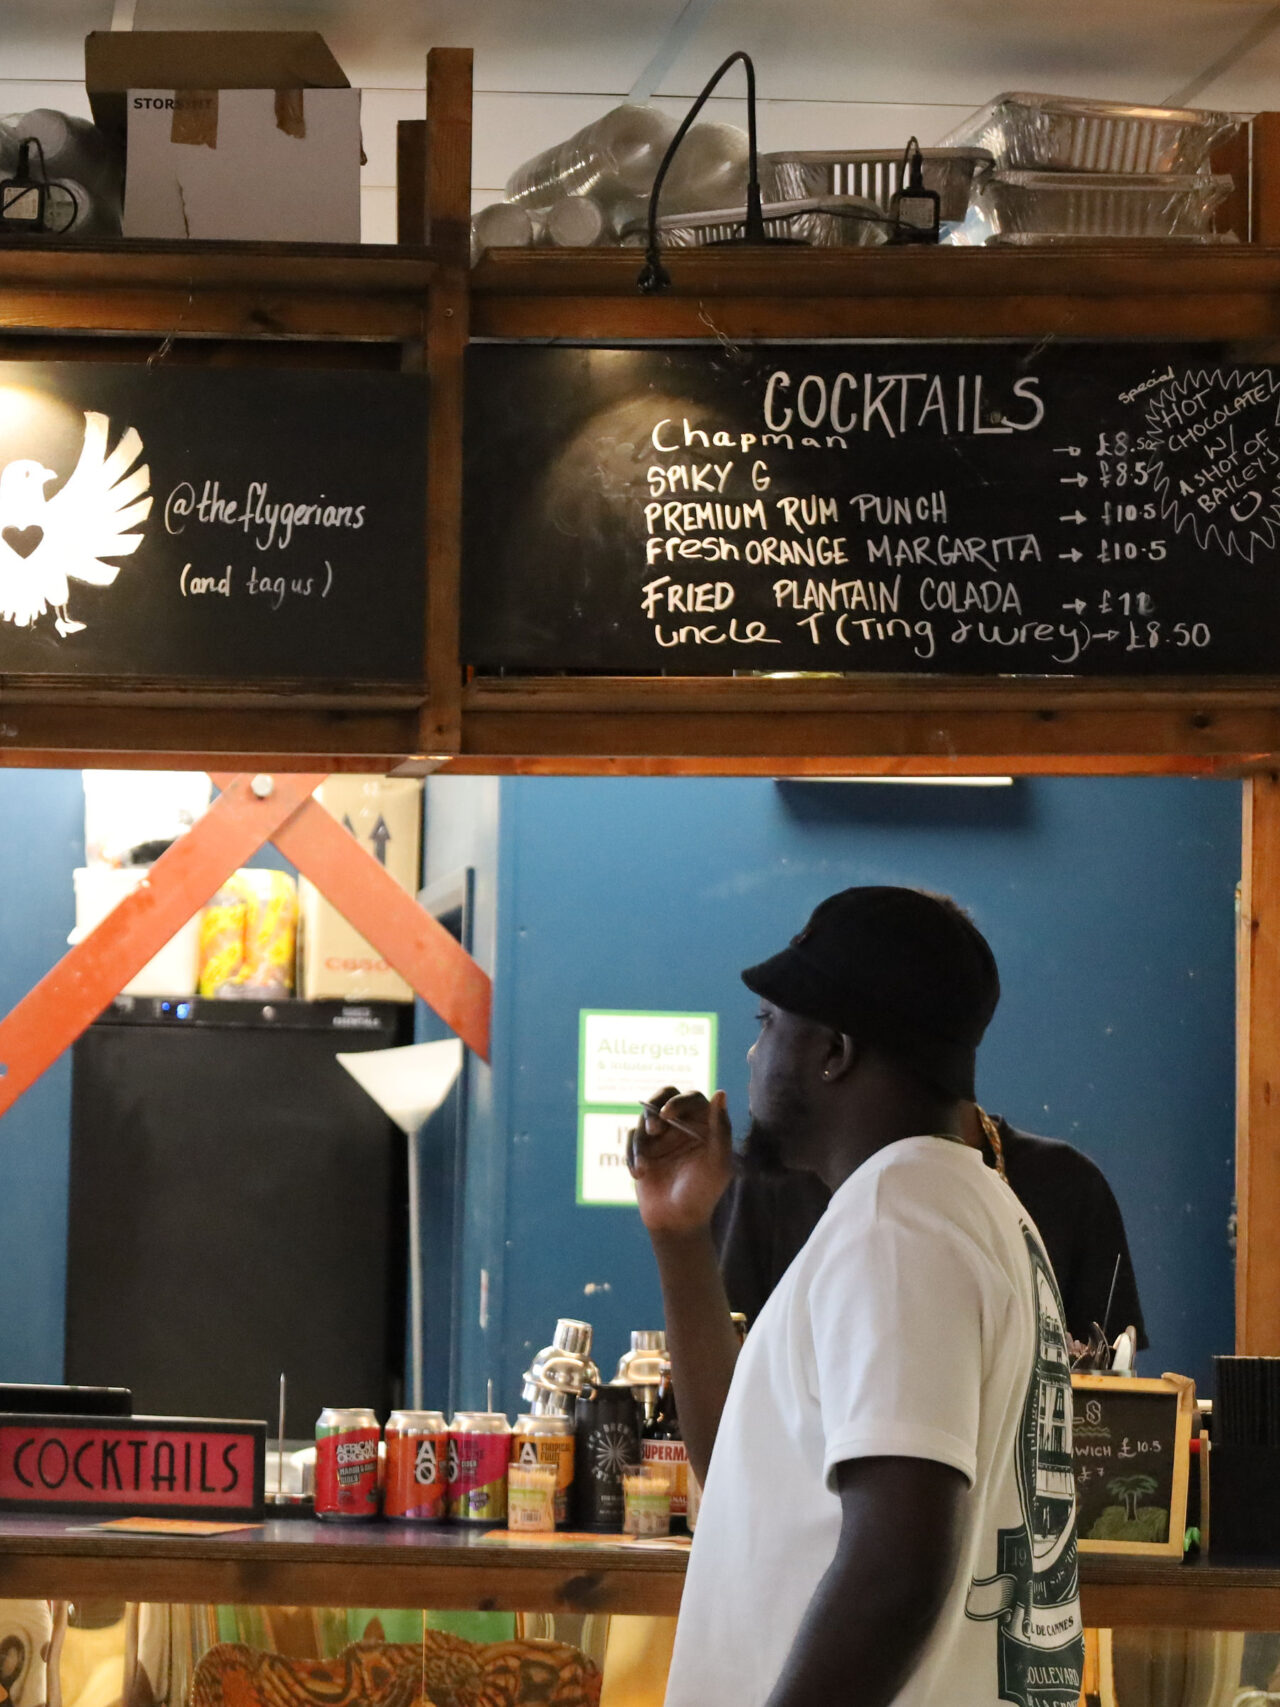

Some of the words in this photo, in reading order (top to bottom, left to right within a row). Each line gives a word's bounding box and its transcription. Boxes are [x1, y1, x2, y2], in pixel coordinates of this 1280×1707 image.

[763, 370, 1045, 438] COCKTAILS
[1161, 388, 1211, 428] HOT
[1168, 384, 1271, 452] CHOCOLATE
[651, 418, 848, 453] Chapman
[1194, 451, 1238, 487] SHOT
[1243, 429, 1270, 456] OF
[647, 461, 734, 497] SPIKY
[752, 460, 772, 492] G
[1099, 459, 1149, 489] £8.5
[1197, 447, 1279, 513] BAILEY'S
[644, 499, 767, 536] PREMIUM
[776, 493, 839, 534] RUM
[850, 490, 947, 525] PUNCH
[1101, 501, 1156, 526] £10.5
[745, 536, 849, 567] ORANGE
[867, 534, 1042, 572] MARGARITA
[1097, 539, 1167, 563] £10.5
[180, 562, 233, 597] (and
[246, 566, 286, 610] tag
[641, 576, 734, 619] FRIED
[772, 574, 901, 613] PLANTAIN
[920, 576, 1022, 616] COLADA
[797, 612, 825, 645] T
[1125, 620, 1211, 651] £8.50
[597, 1038, 700, 1059] Allergens
[13, 1437, 239, 1493] COCKTAILS
